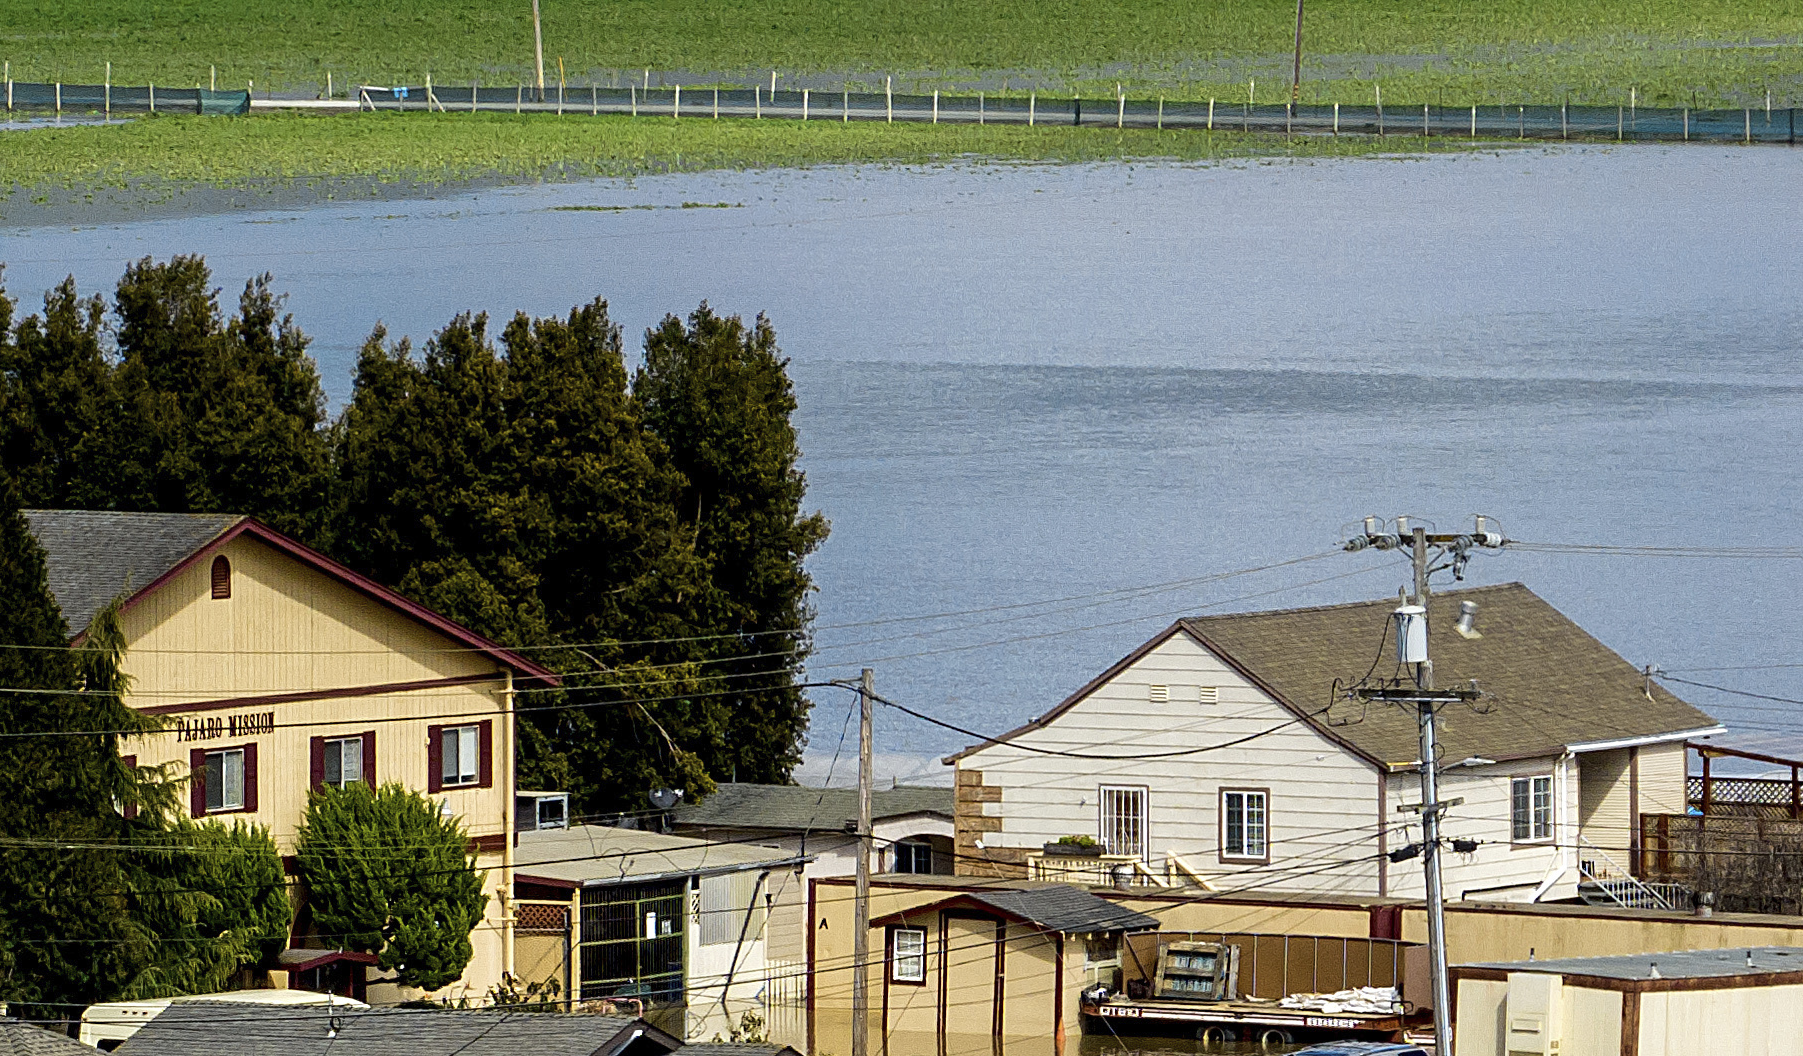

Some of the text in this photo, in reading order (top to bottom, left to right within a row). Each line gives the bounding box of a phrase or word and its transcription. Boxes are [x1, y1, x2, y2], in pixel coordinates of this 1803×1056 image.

[177, 711, 275, 743] PAJARO MISSION
[818, 917, 829, 930] A
